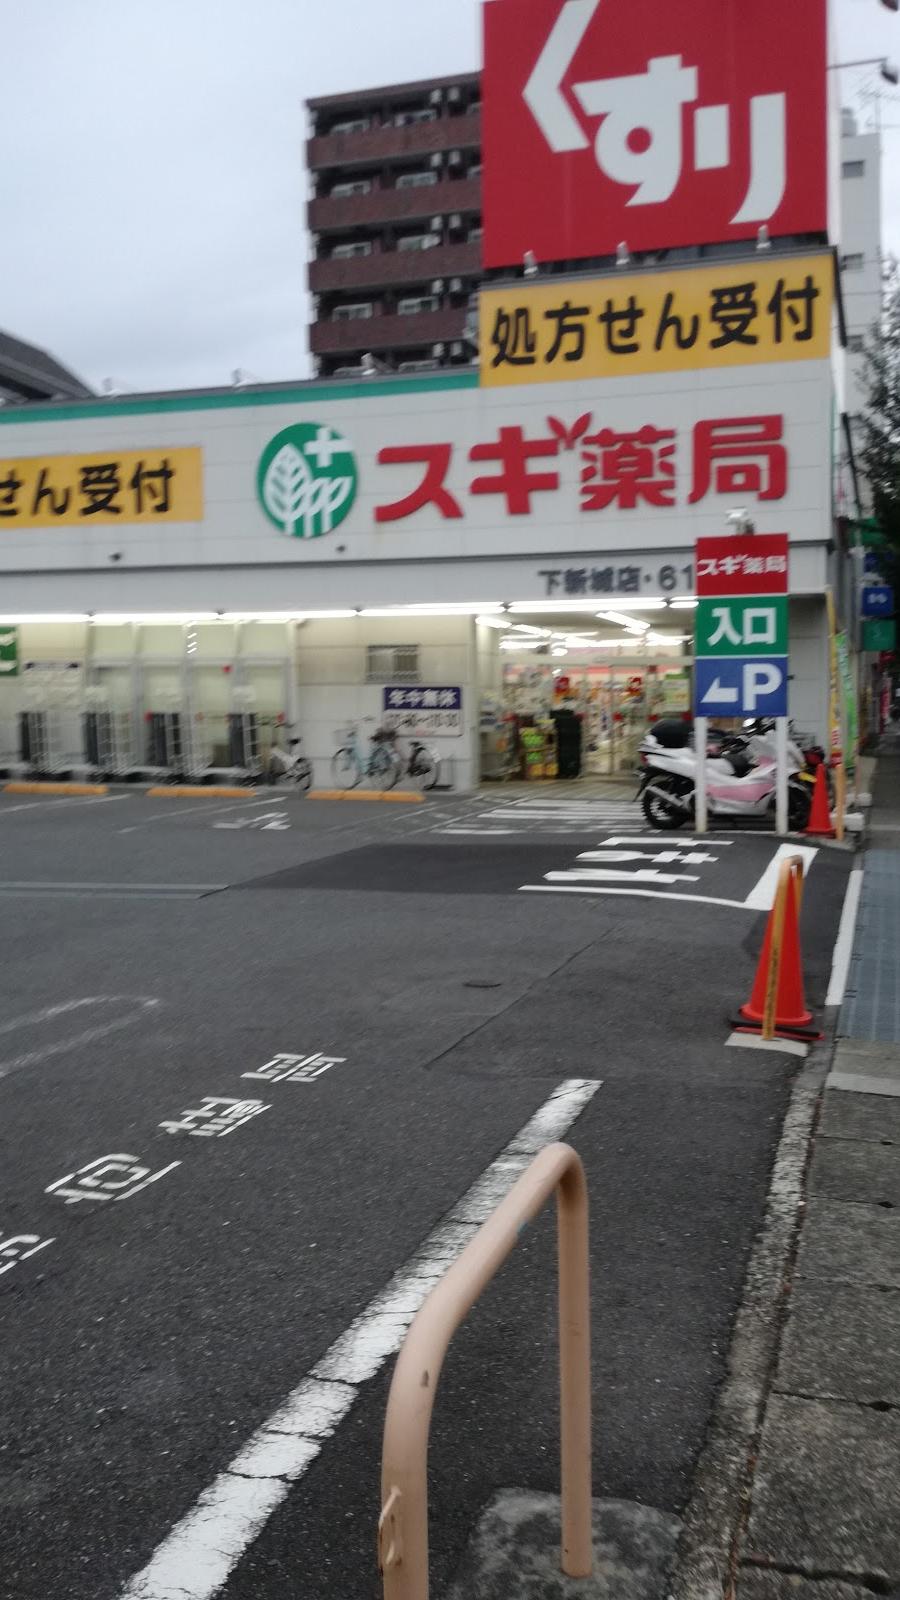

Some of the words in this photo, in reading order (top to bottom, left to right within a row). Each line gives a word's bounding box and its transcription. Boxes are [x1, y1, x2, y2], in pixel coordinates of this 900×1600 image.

[521, 0, 787, 225] くすり
[491, 275, 820, 369] 処方せん受付
[374, 411, 788, 520] スギ薬局
[697, 553, 788, 577] スギ薬局
[707, 606, 777, 647] 入口
[742, 663, 783, 712] P
